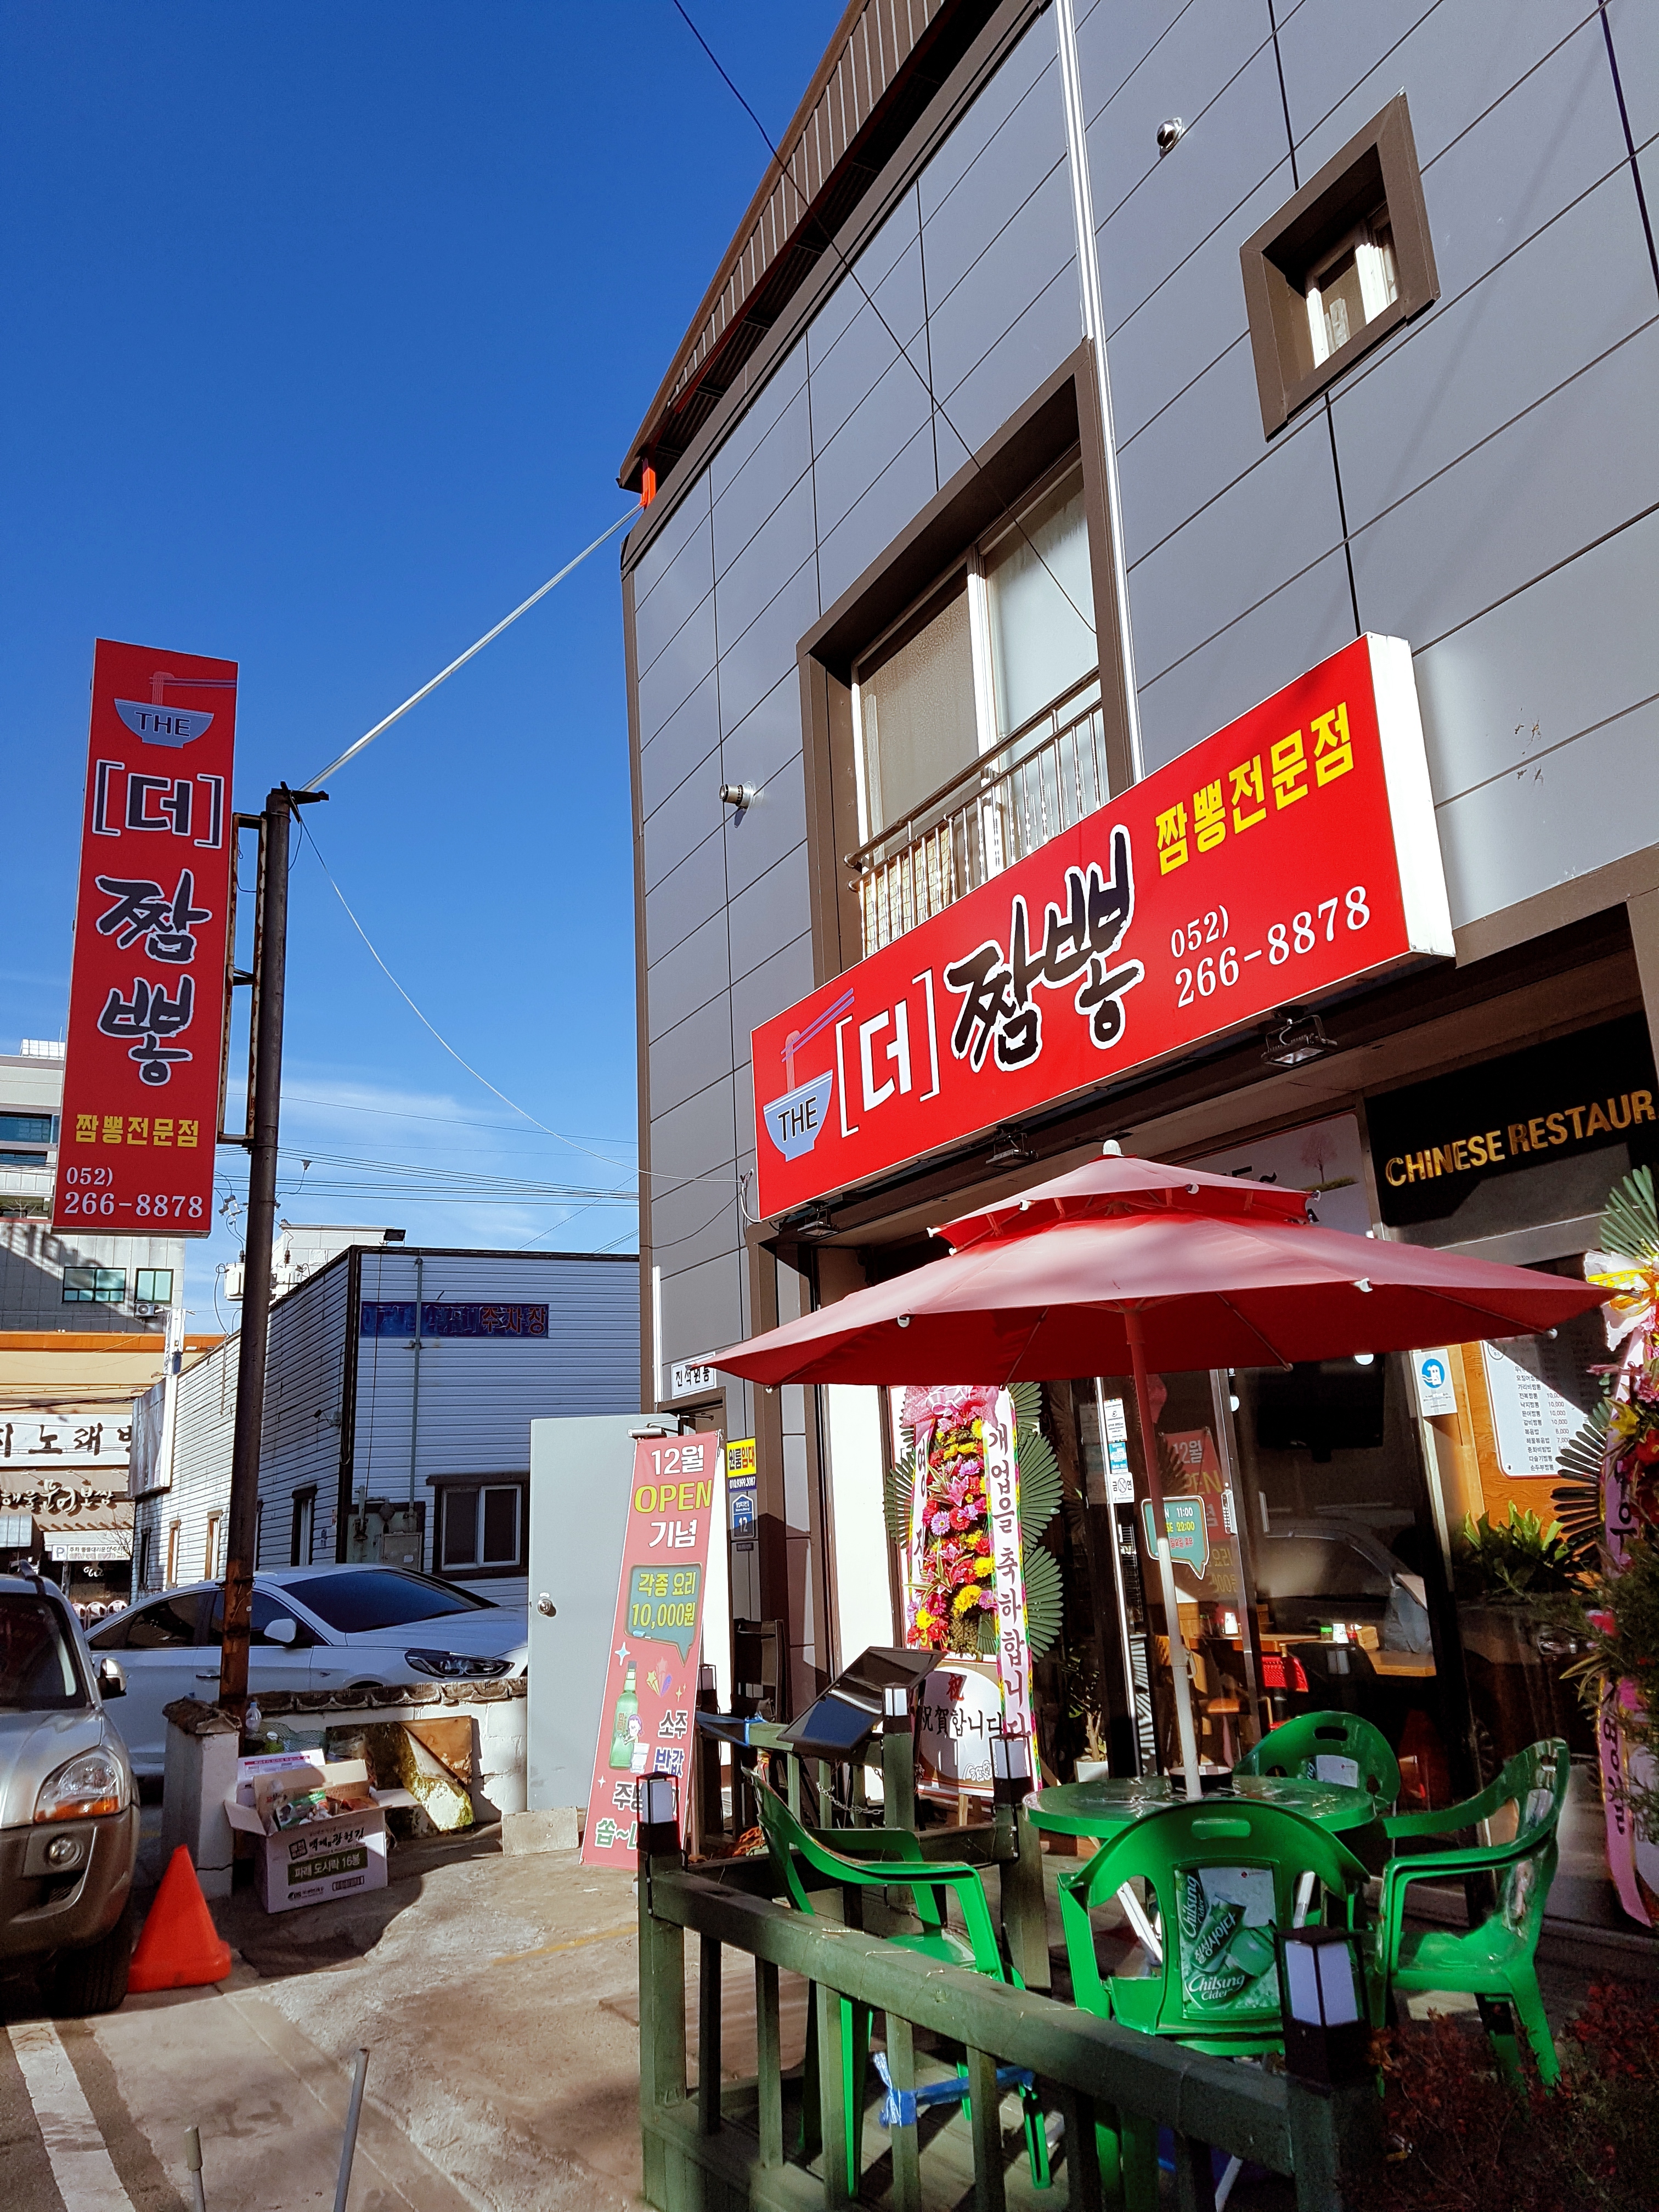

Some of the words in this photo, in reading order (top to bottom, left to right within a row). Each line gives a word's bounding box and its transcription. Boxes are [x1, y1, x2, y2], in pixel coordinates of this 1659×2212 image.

[134, 709, 192, 739] THE
[1155, 702, 1354, 876] 짬뽕전문점
[1170, 904, 1229, 958] 052)
[944, 825, 1145, 1071] 짬뽕
[1175, 885, 1370, 1008] 266-8878
[95, 868, 212, 1086] 짬뽕
[75, 1113, 199, 1148] 짬뽕전문점
[777, 1096, 818, 1142] THE
[1385, 1130, 1505, 1187] CHINESE
[1508, 1090, 1657, 1155] RESTAUR
[65, 1166, 113, 1188] 052)
[64, 1192, 204, 1218] 266-8878
[481, 1306, 547, 1335] 주차장
[651, 1443, 705, 1476] 12월
[729, 1446, 755, 1471] 원룸임대
[989, 1423, 1015, 1534] 개업을
[634, 1479, 713, 1513] OPEN
[738, 1516, 748, 1532] 12
[1176, 1507, 1193, 1517] 11:00
[1176, 1521, 1195, 1532] 22:00
[648, 1519, 697, 1549] 기념
[638, 1572, 669, 1598] 각종
[672, 1571, 696, 1596] 요리
[632, 1602, 696, 1630] 10,000원
[658, 1709, 688, 1739] 소주
[313, 1857, 340, 1874] 도시락
[1181, 1875, 1199, 1938] Chilsung
[1194, 1912, 1237, 1965] 칠성사이다
[1188, 1973, 1245, 1993] Chilsung
[1201, 1989, 1228, 2001] Cider
